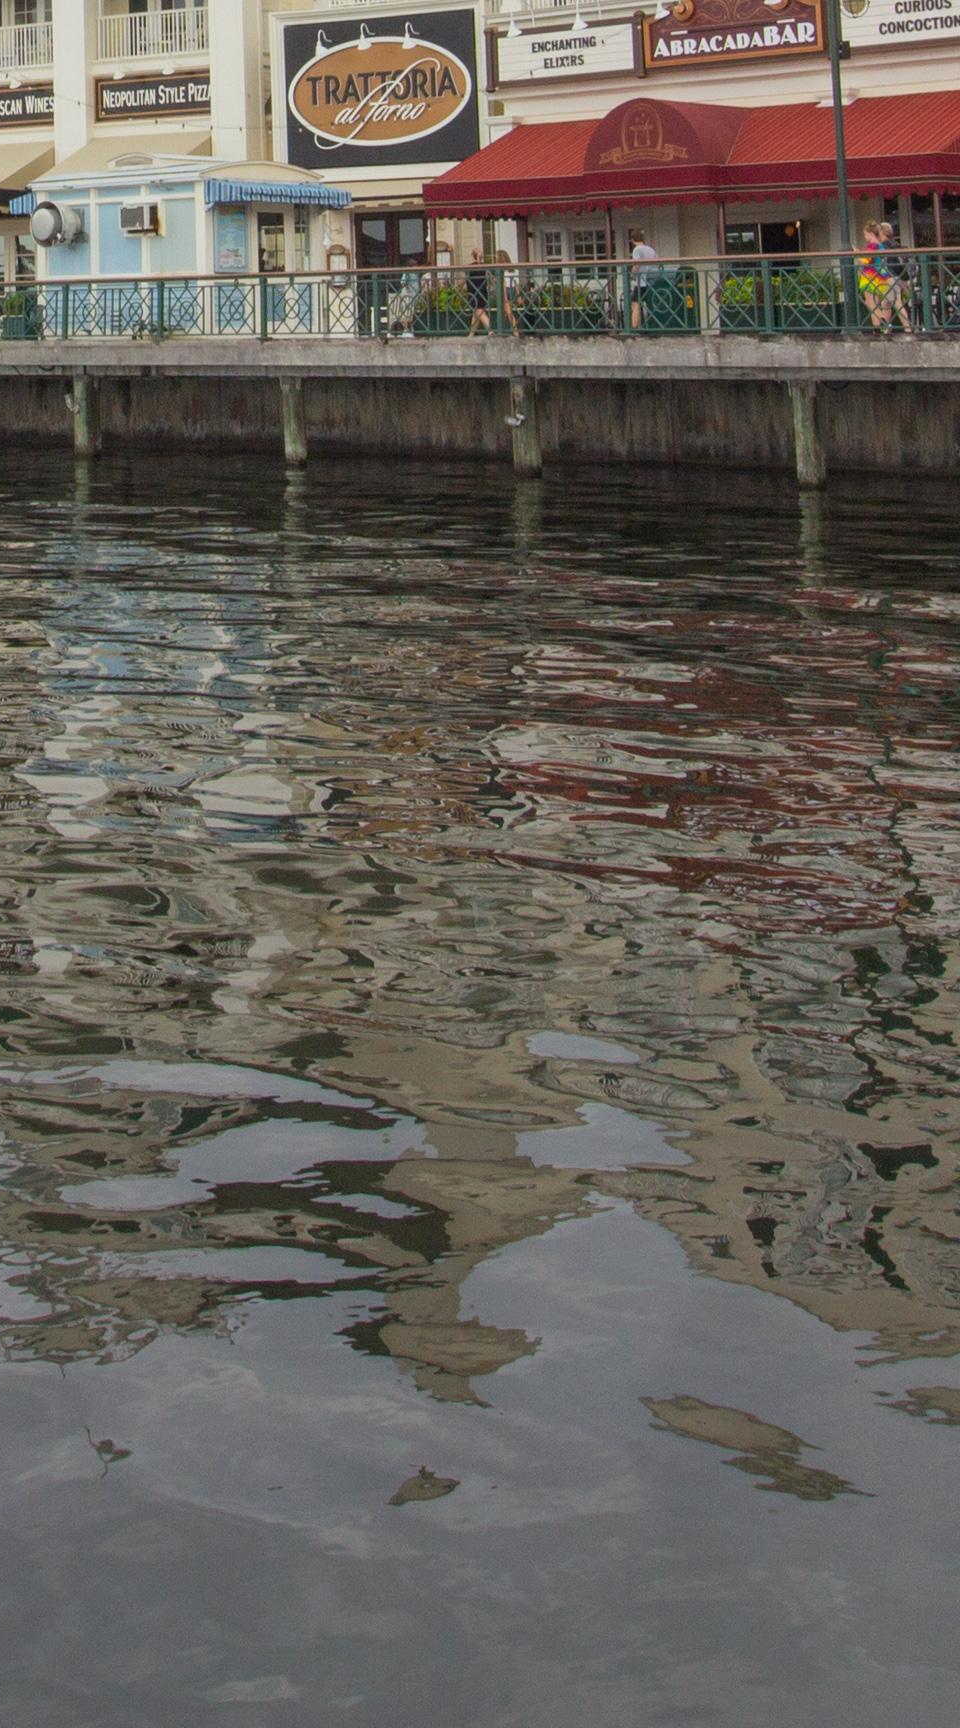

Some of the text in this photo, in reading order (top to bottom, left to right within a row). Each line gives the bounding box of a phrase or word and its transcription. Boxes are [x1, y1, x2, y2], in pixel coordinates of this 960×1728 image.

[531, 36, 597, 53] ENCHANTING
[653, 19, 815, 58] ABRACADABAR
[103, 88, 156, 108] NEOPOLITAN
[158, 85, 186, 104] STYLE
[306, 67, 459, 107] TRATTORIA
[25, 95, 54, 114] WINES
